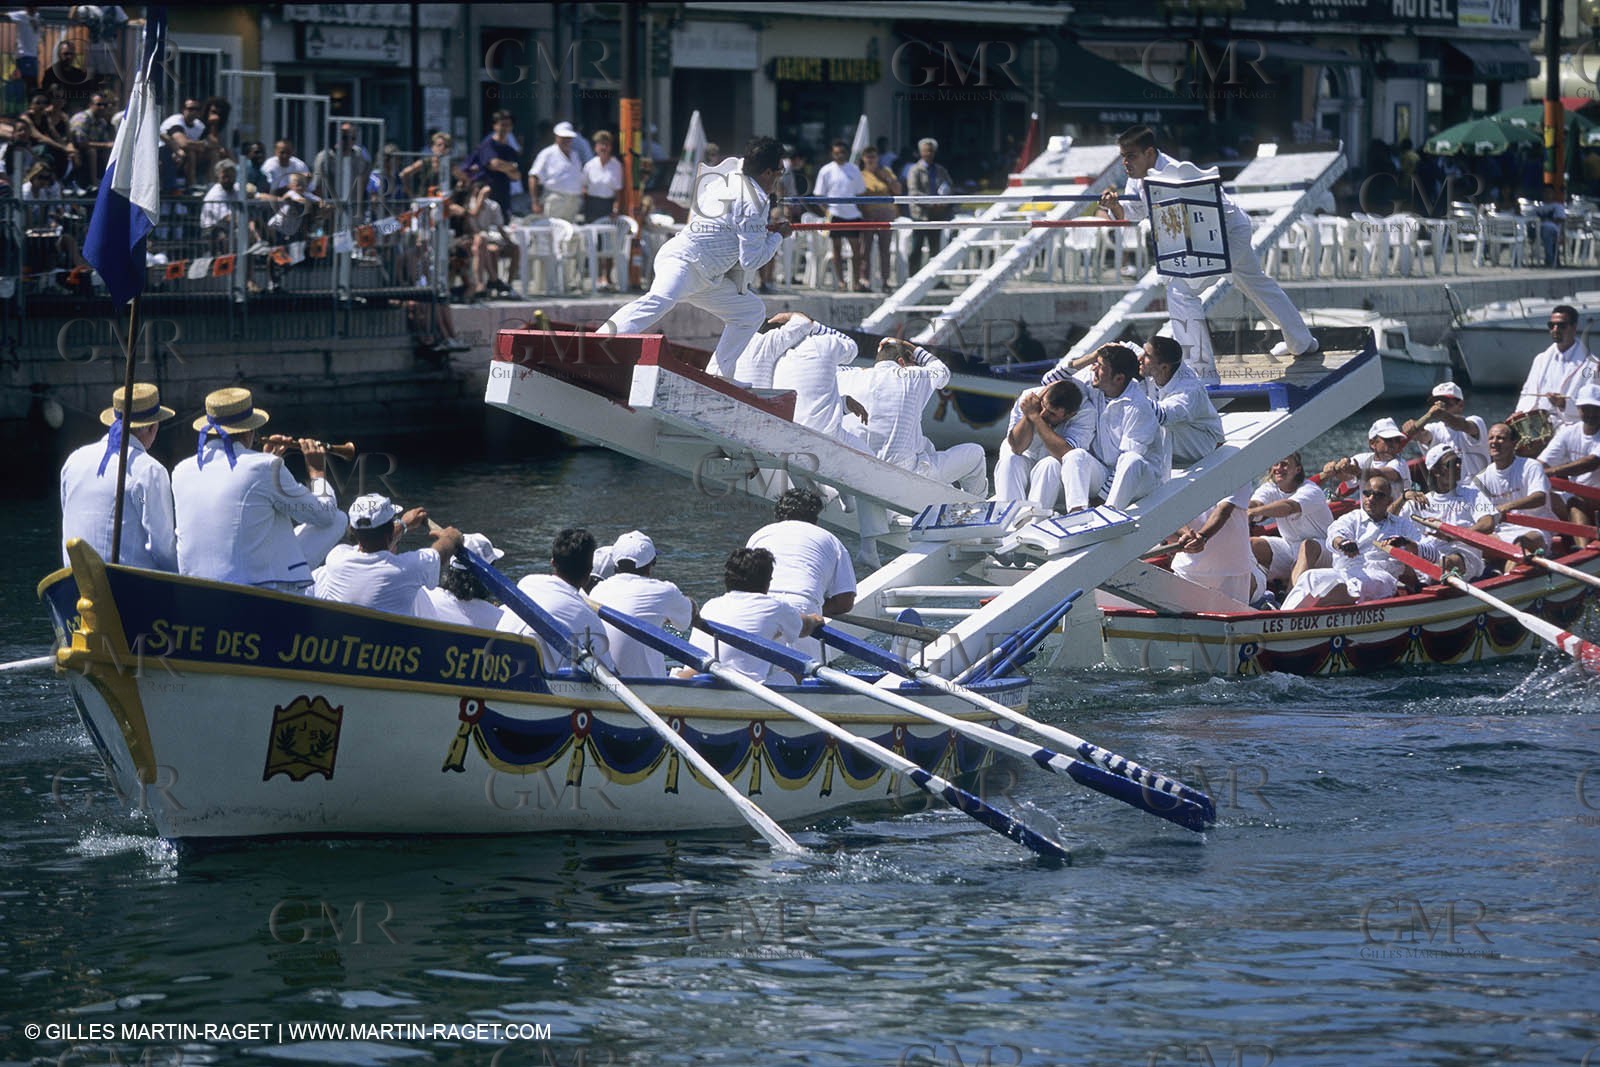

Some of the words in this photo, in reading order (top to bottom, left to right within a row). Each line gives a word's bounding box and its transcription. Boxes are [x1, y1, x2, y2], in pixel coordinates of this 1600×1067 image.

[1263, 619, 1284, 633] LES
[1290, 615, 1319, 630] DEUX
[1326, 608, 1385, 628] CETTOISES
[215, 629, 261, 661] DES
[278, 633, 421, 674] JOUTEURS
